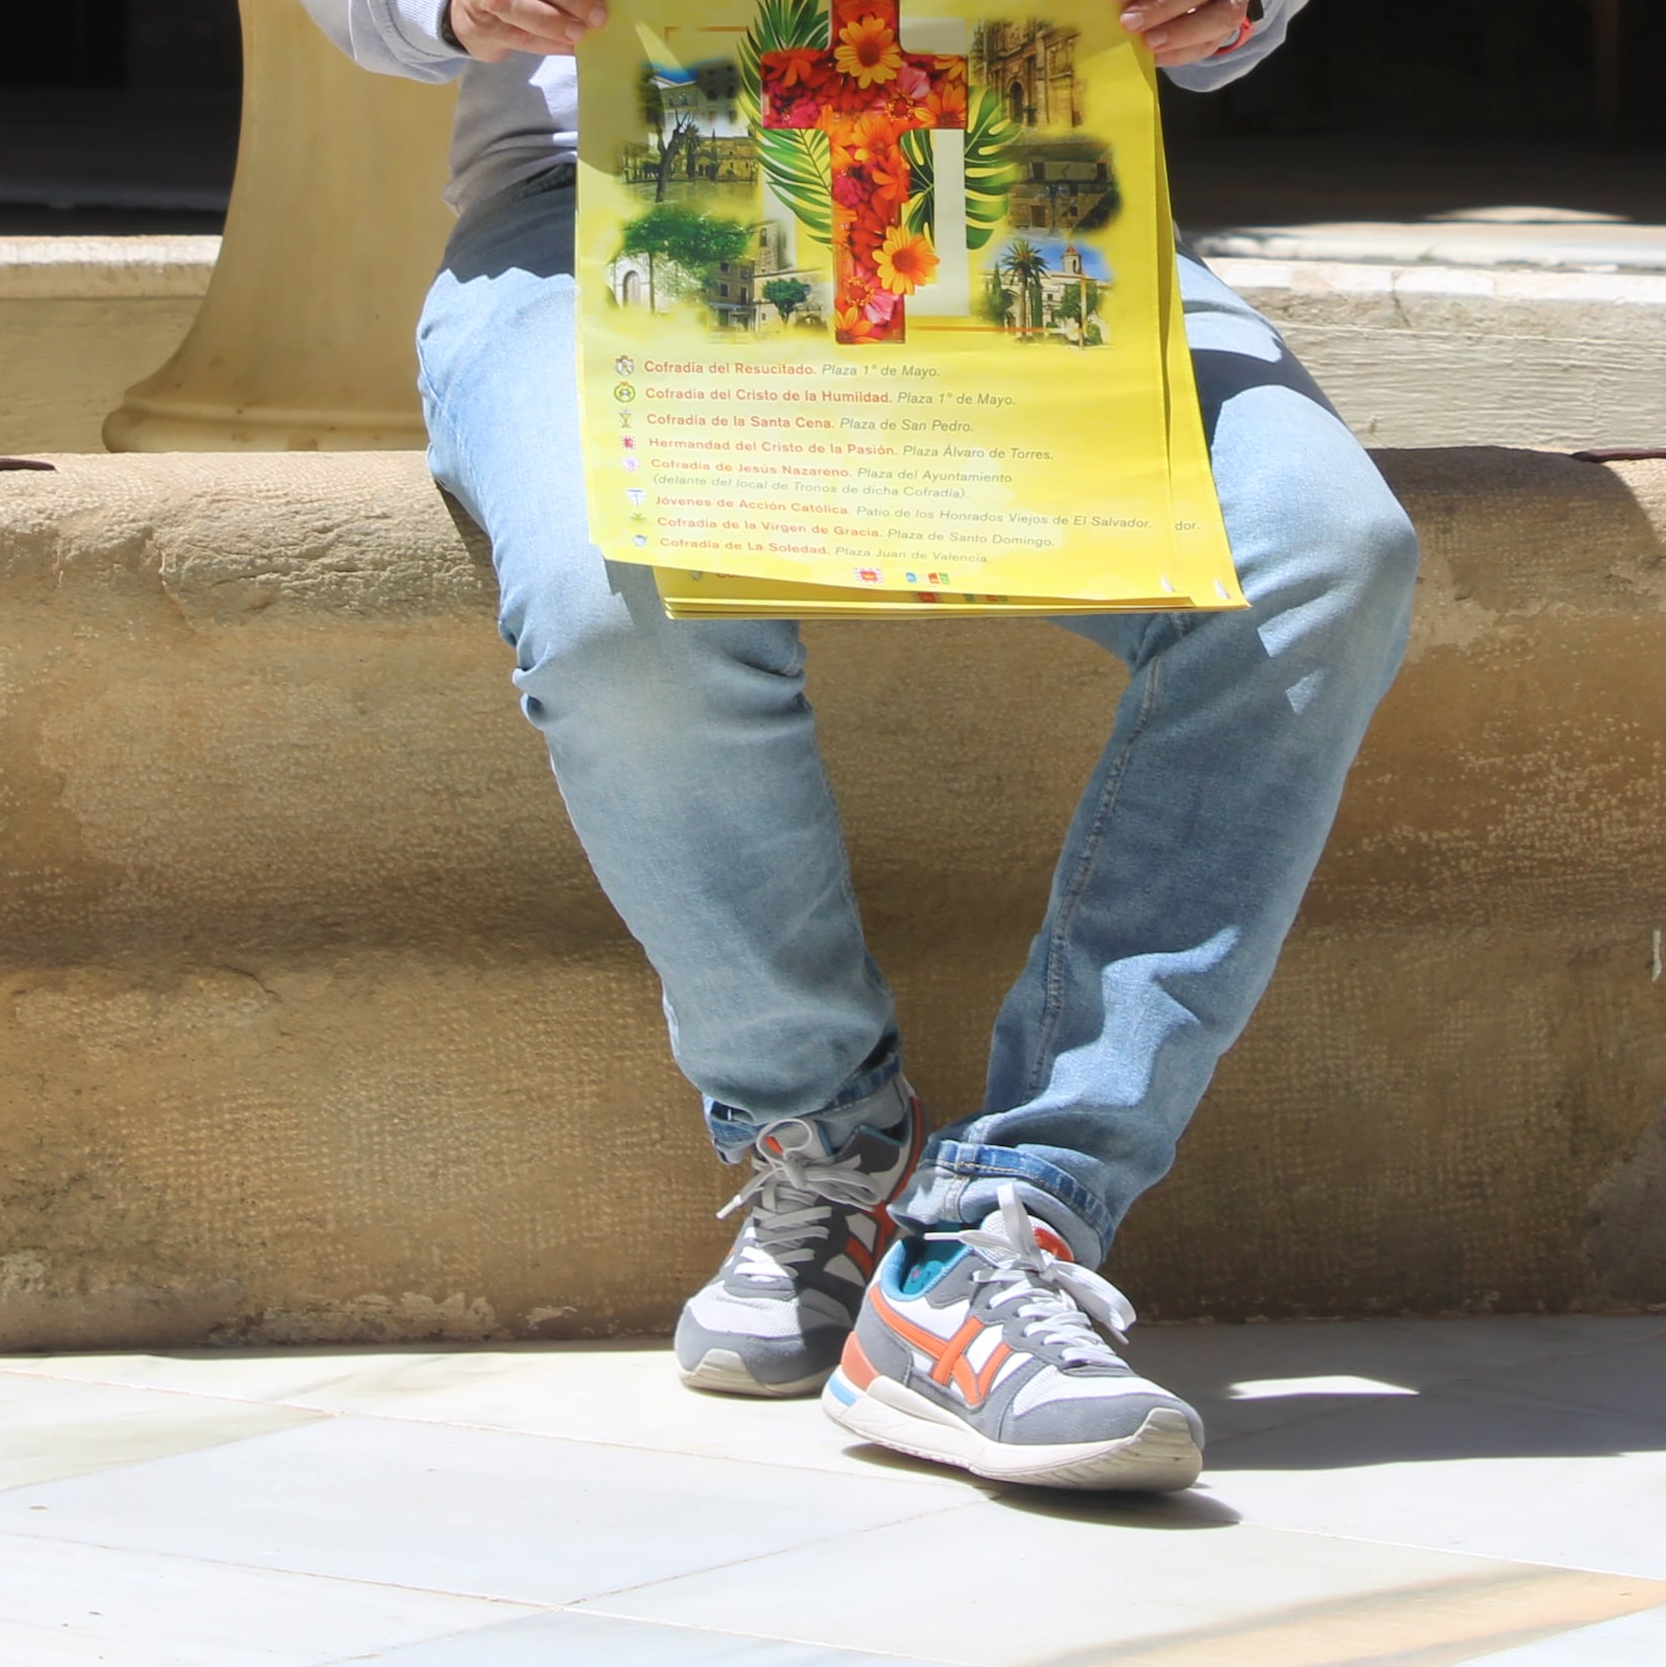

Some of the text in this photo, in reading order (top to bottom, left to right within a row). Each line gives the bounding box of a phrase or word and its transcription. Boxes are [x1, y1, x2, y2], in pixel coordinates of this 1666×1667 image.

[644, 360, 703, 374] Cofradía
[709, 362, 730, 374] del
[735, 363, 816, 375] Resucitado.
[822, 364, 857, 376] Plaza
[880, 365, 897, 376] de
[902, 365, 940, 379] Mayo.
[645, 387, 704, 400] Cofradía
[710, 389, 731, 400] del
[736, 389, 778, 401] Cristo
[783, 390, 800, 402] de
[805, 390, 817, 402] la
[822, 390, 892, 403] Humildad.
[898, 392, 933, 404] Plaza
[956, 393, 973, 405] de
[977, 393, 1016, 408] Mayo.
[647, 413, 974, 432] Cofradía de la Santa Cena. Plaza de San Pedro.
[649, 437, 1053, 460] Hermandad del Cristo de la Pasión. Plaza Álvaro de Torres.
[651, 458, 1012, 483] Cofradía de Jesús Nazareno. Plaza del Ayuntamiento
[653, 473, 707, 486] (delante
[711, 476, 732, 487] del
[736, 478, 767, 489] local
[771, 480, 789, 491] de
[793, 481, 837, 493] Tronos
[842, 483, 859, 494] de
[863, 484, 898, 496] dicha
[655, 495, 1152, 529] Jóvenes de Acción Católica. Patio de los Honrados Viejos de El Salvador.
[657, 517, 1054, 549] Cofradía de la Virgen de Gracia. Plaza de Santo Domingo.
[660, 537, 989, 564] Cofradía de La Soledad. Plaza Juan de Valencia.
